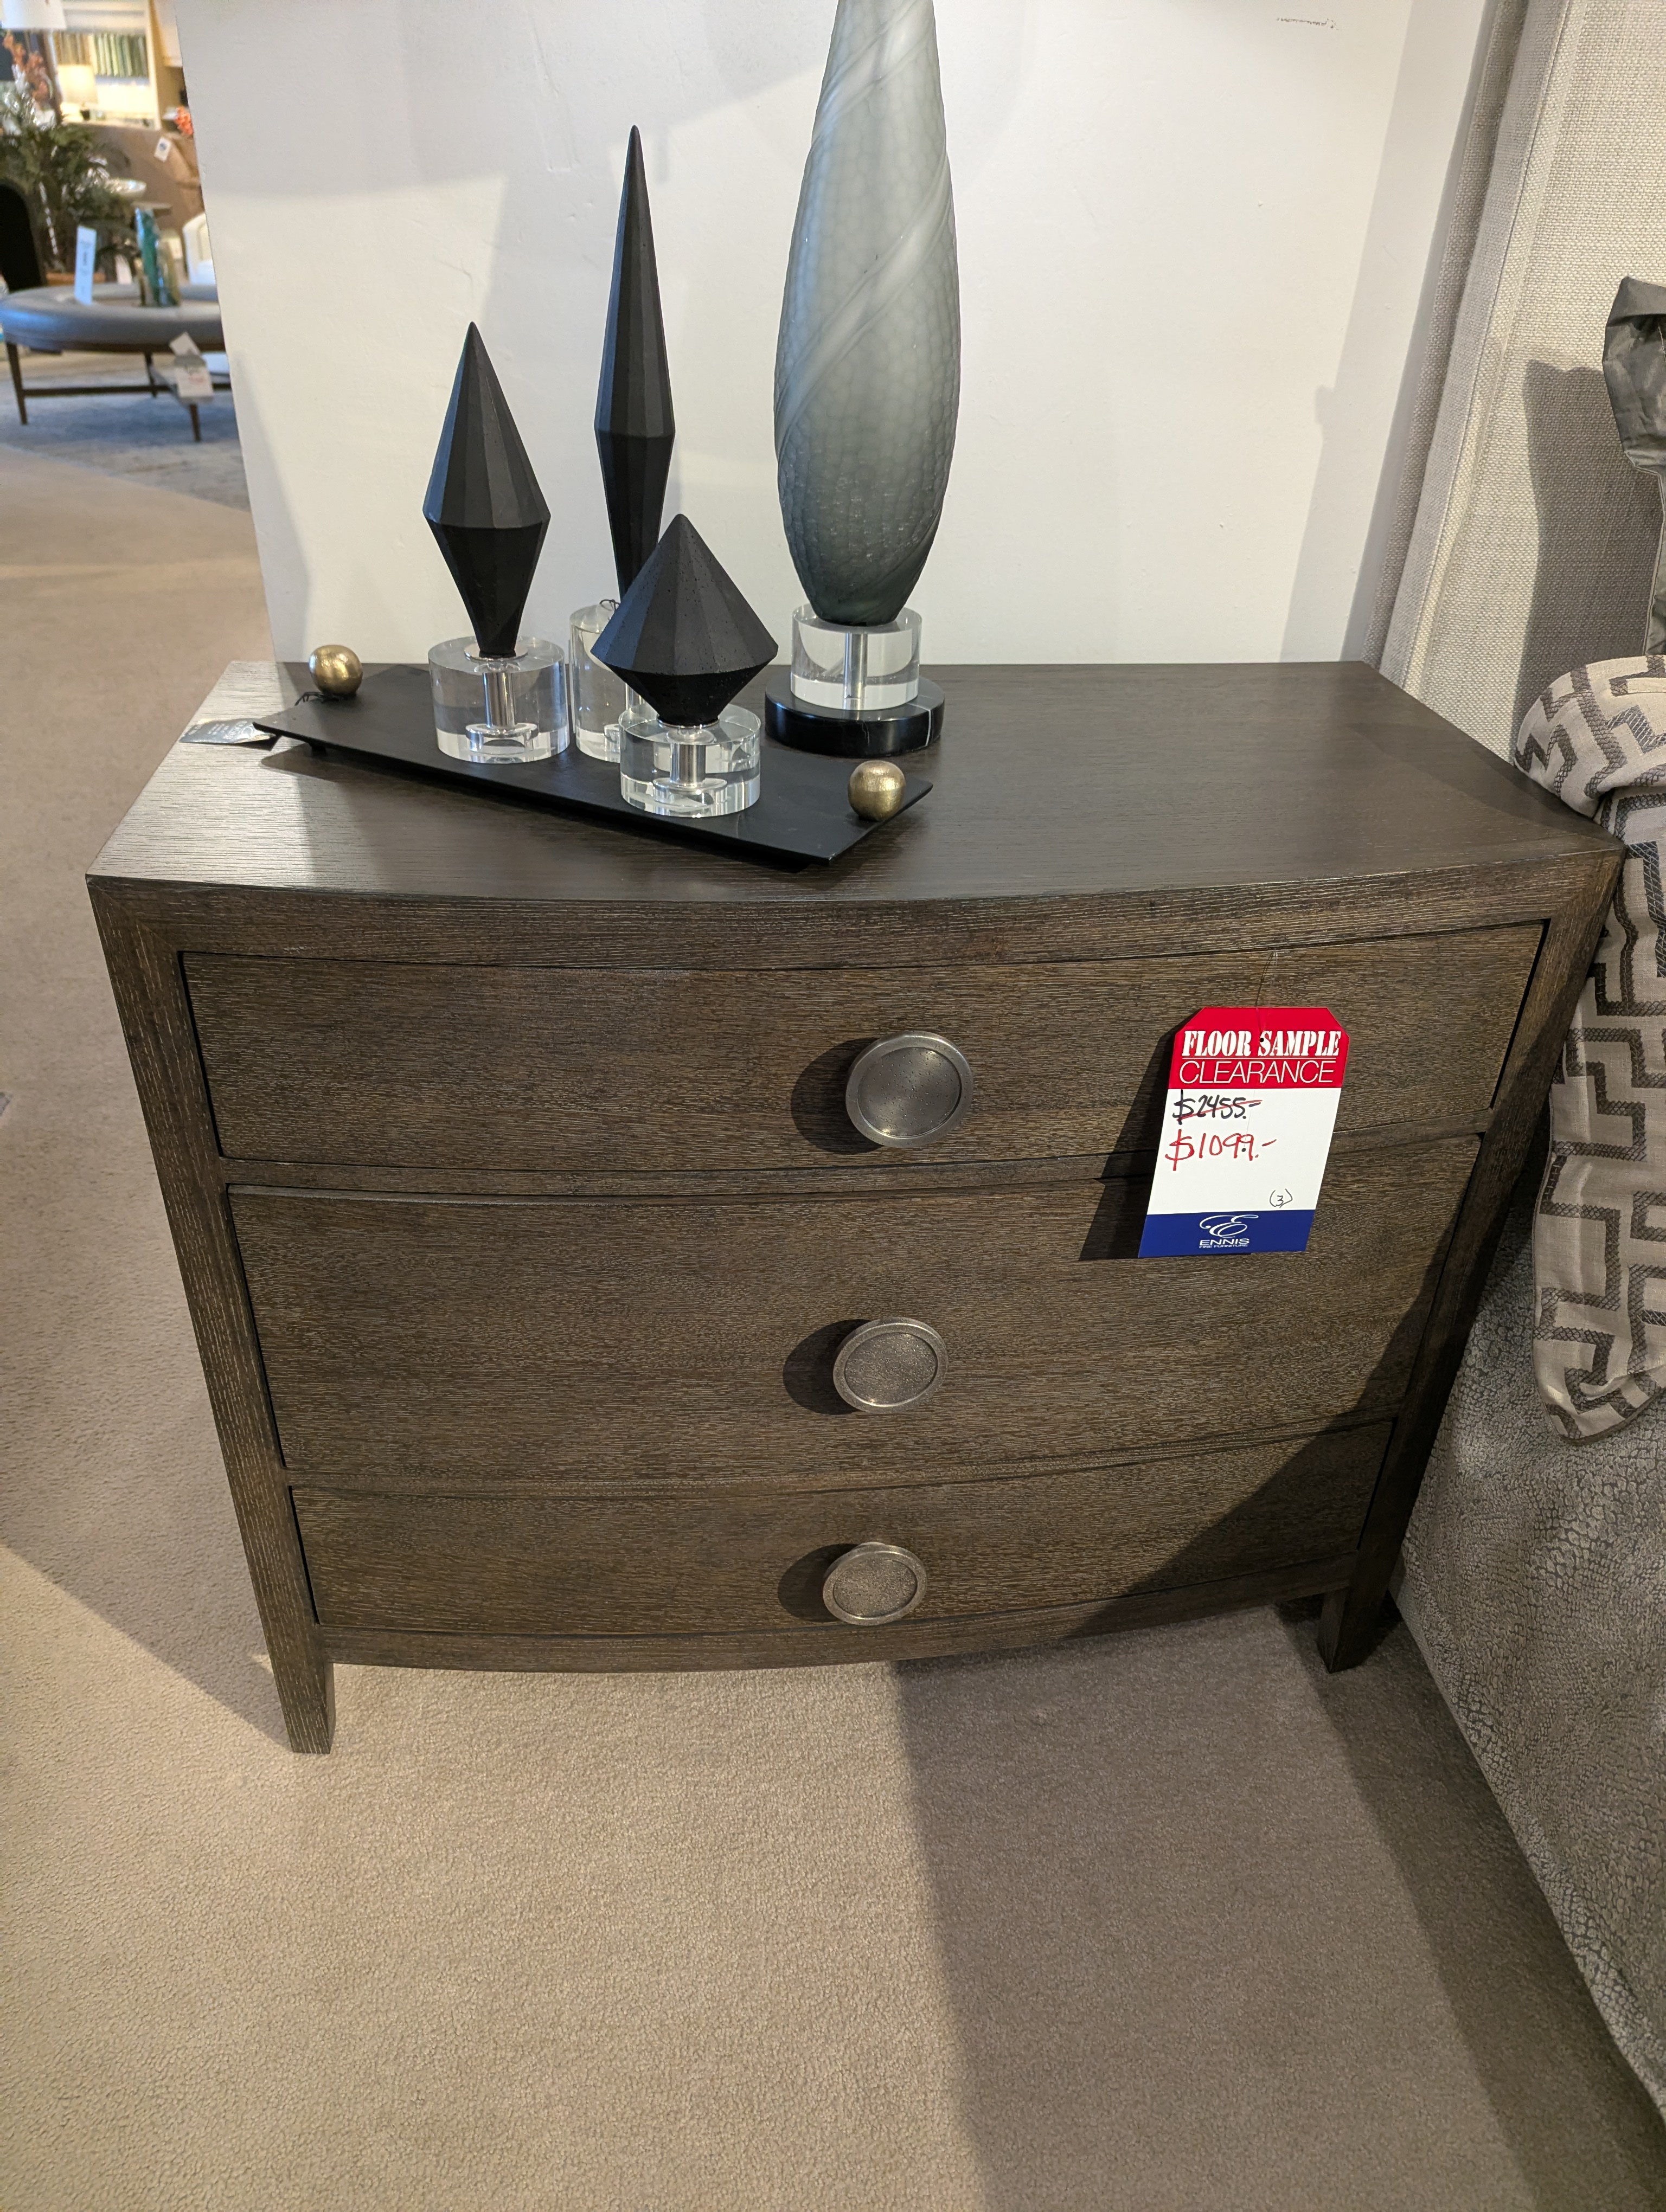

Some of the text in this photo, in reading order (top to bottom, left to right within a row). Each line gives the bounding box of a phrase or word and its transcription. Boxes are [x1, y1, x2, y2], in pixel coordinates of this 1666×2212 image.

[1182, 1030, 1341, 1057] FLOOR SAMPLE
[1180, 1060, 1336, 1084] CLEARANCE
